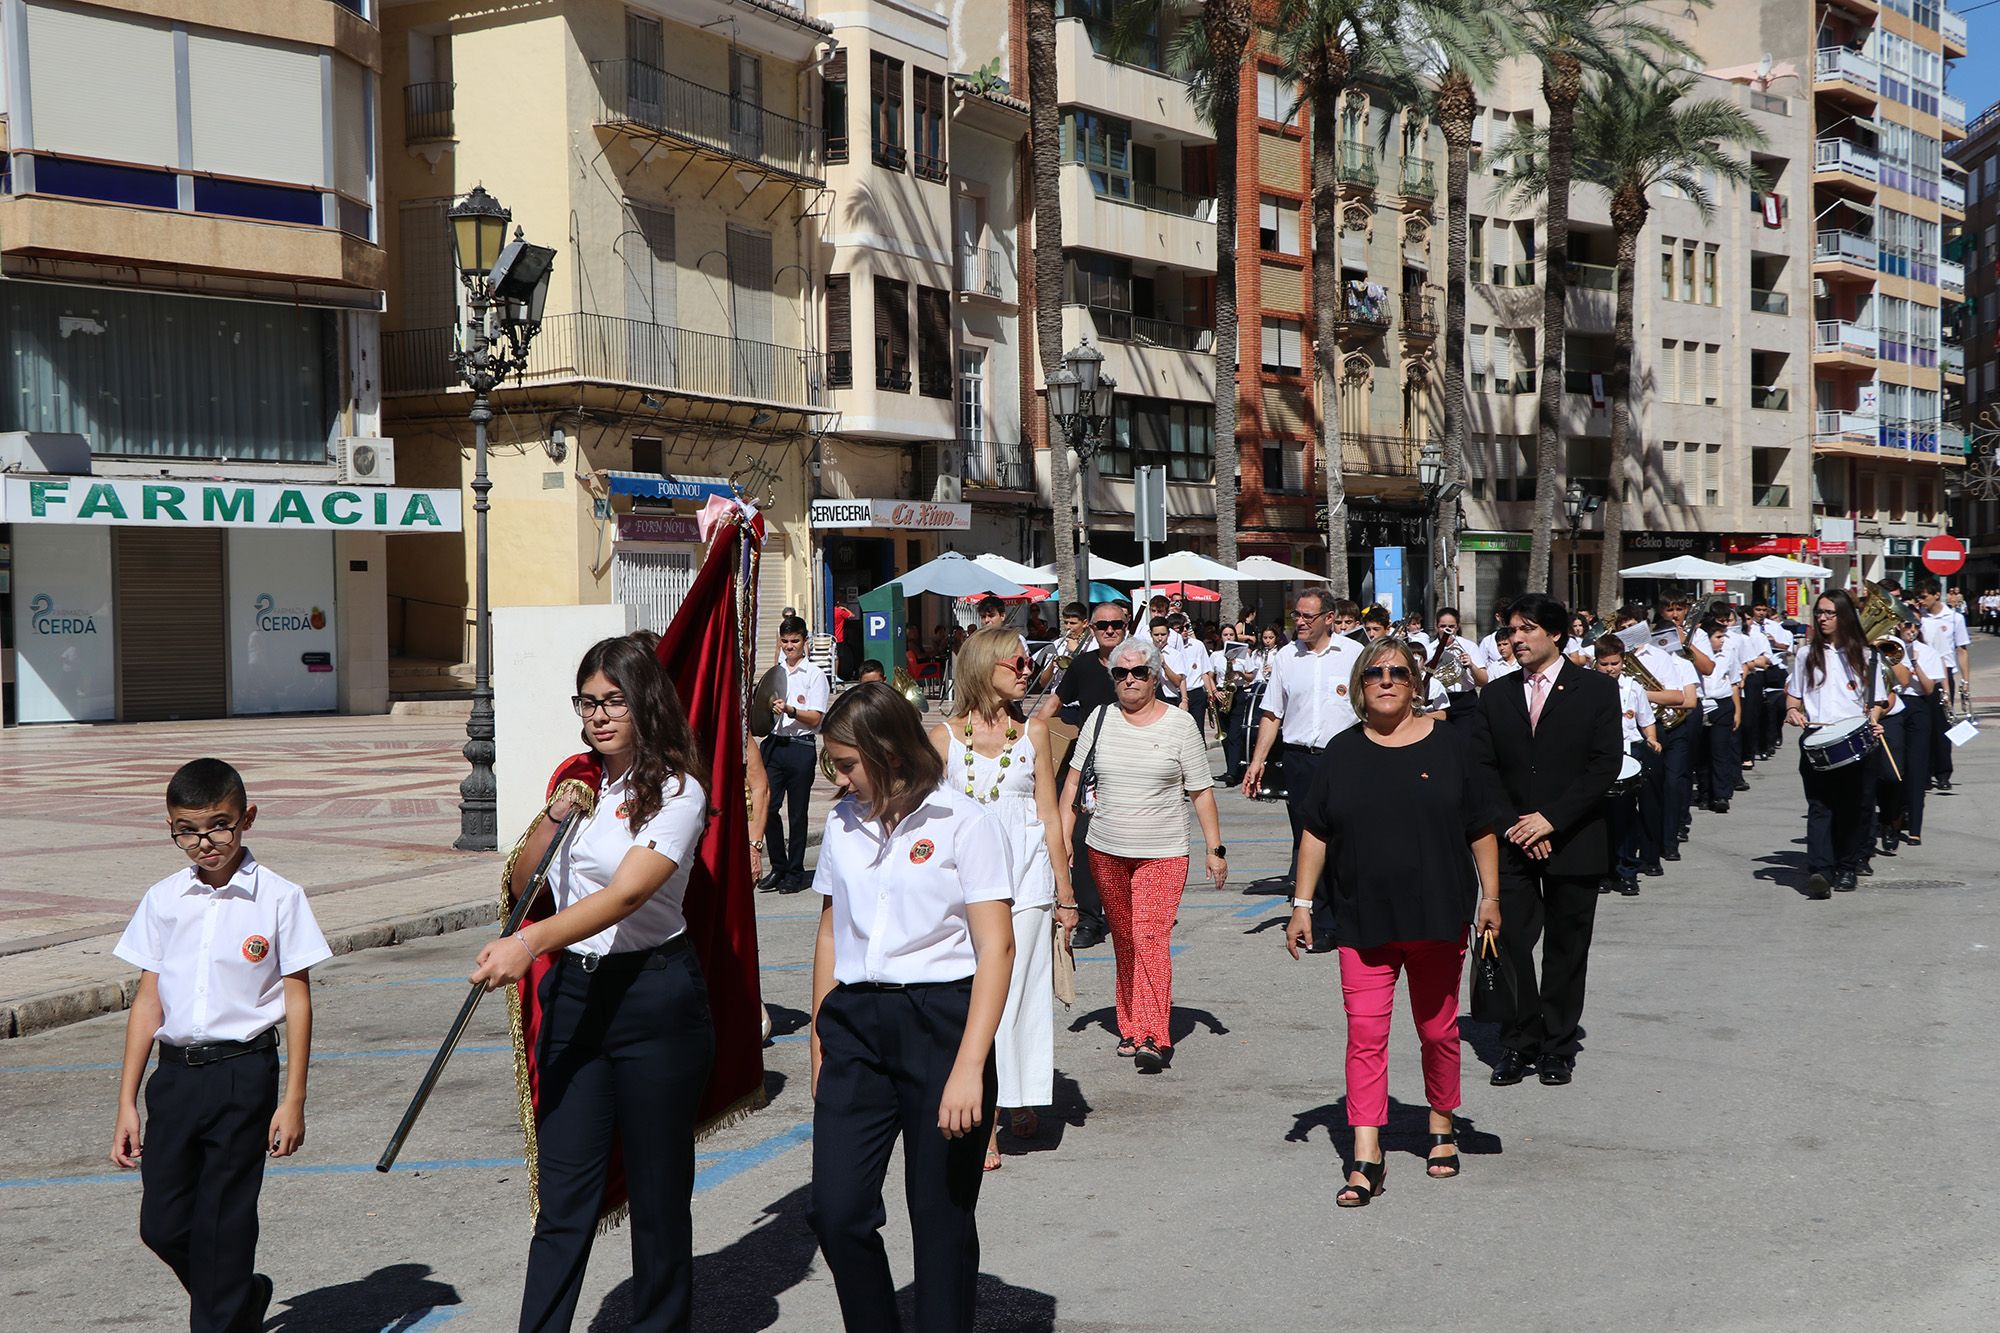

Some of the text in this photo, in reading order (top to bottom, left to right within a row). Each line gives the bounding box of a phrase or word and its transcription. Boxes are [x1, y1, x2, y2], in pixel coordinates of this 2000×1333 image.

[658, 482, 701, 497] FORN NOU
[29, 481, 442, 526] FARMACIA
[811, 505, 871, 522] CERVECERIA
[635, 518, 685, 534] FORN NOU
[1665, 536, 1694, 550] Burger
[38, 615, 97, 634] CERDÁ
[262, 613, 312, 631] CERDÁ
[870, 616, 886, 636] P
